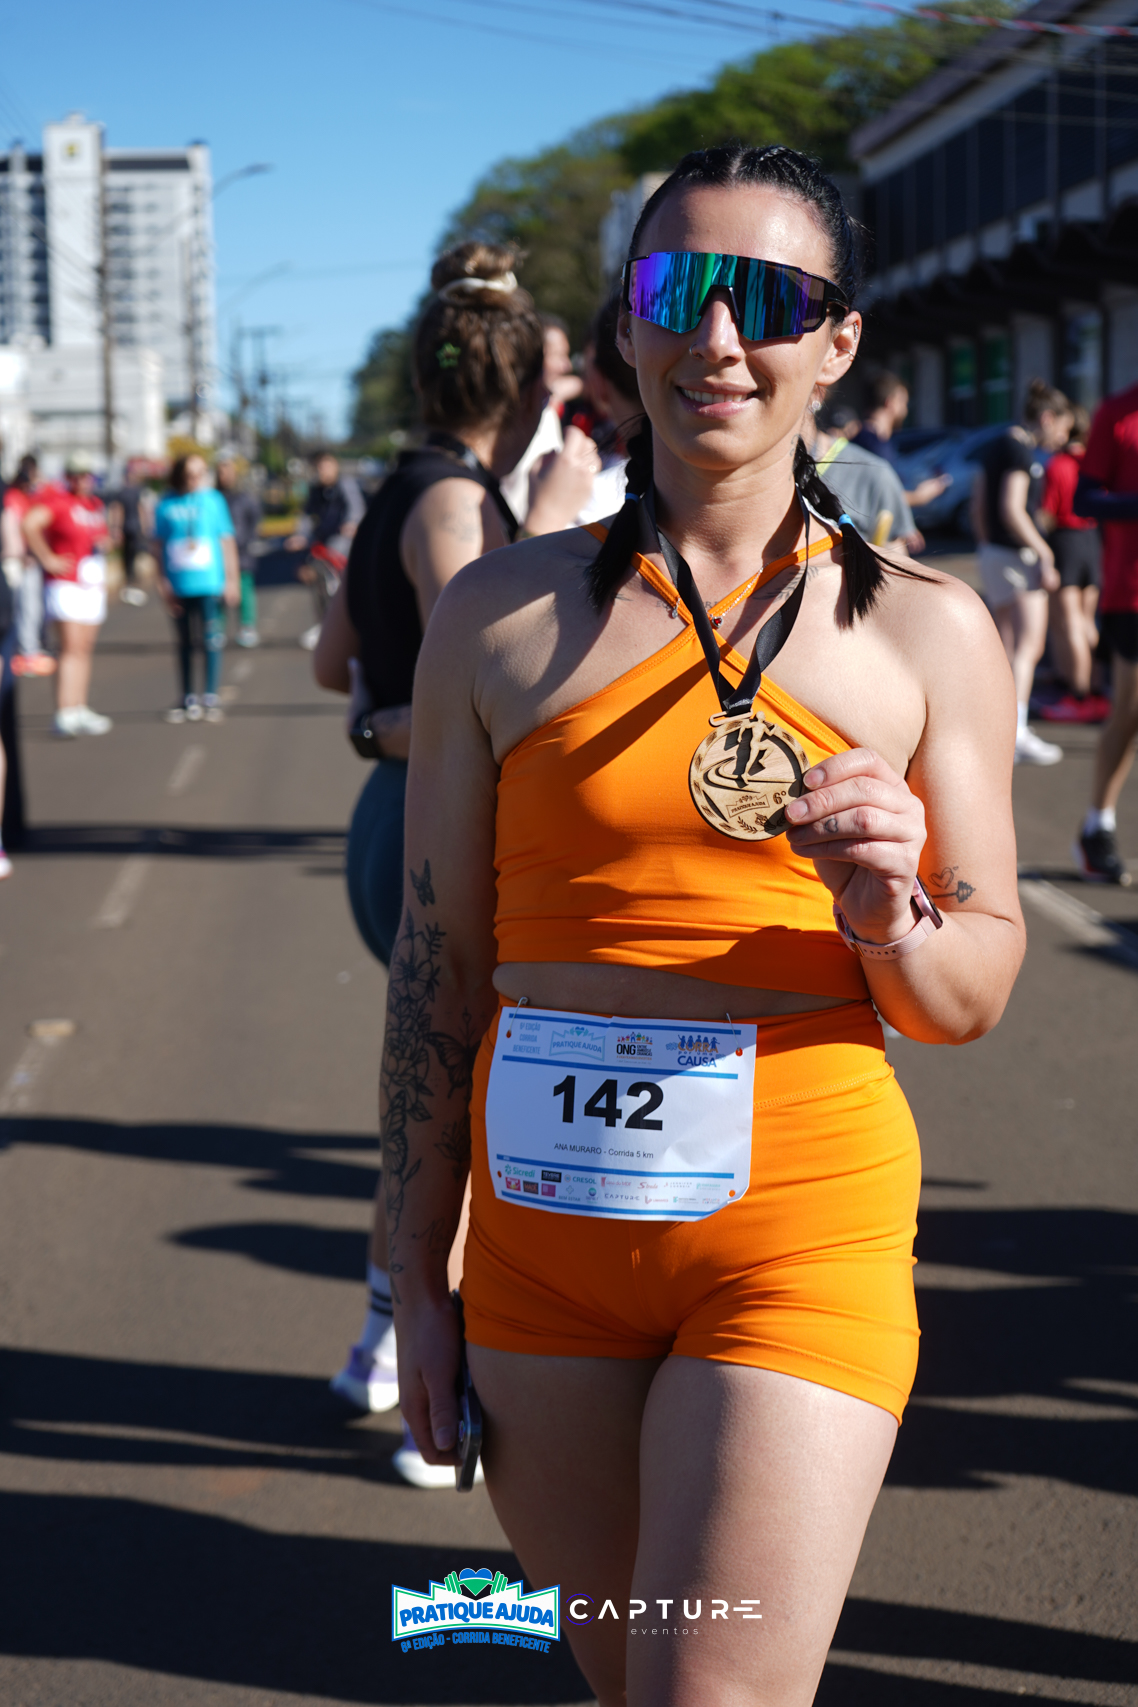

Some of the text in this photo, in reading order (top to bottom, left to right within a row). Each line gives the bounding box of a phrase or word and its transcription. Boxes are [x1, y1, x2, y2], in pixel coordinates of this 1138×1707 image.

[552, 1040, 602, 1053] PRATIQUE AJUDA
[616, 1043, 636, 1056] ONG
[677, 1041, 719, 1053] CORRA
[677, 1055, 718, 1068] CAUSA
[553, 1074, 664, 1131] 142
[554, 1142, 569, 1151] ANA
[569, 1144, 602, 1154] MURARO
[608, 1148, 634, 1158] Corrida
[636, 1150, 641, 1158] 5
[642, 1151, 654, 1159] km
[512, 1166, 536, 1178] Sicredi
[572, 1176, 597, 1185] CRESOL
